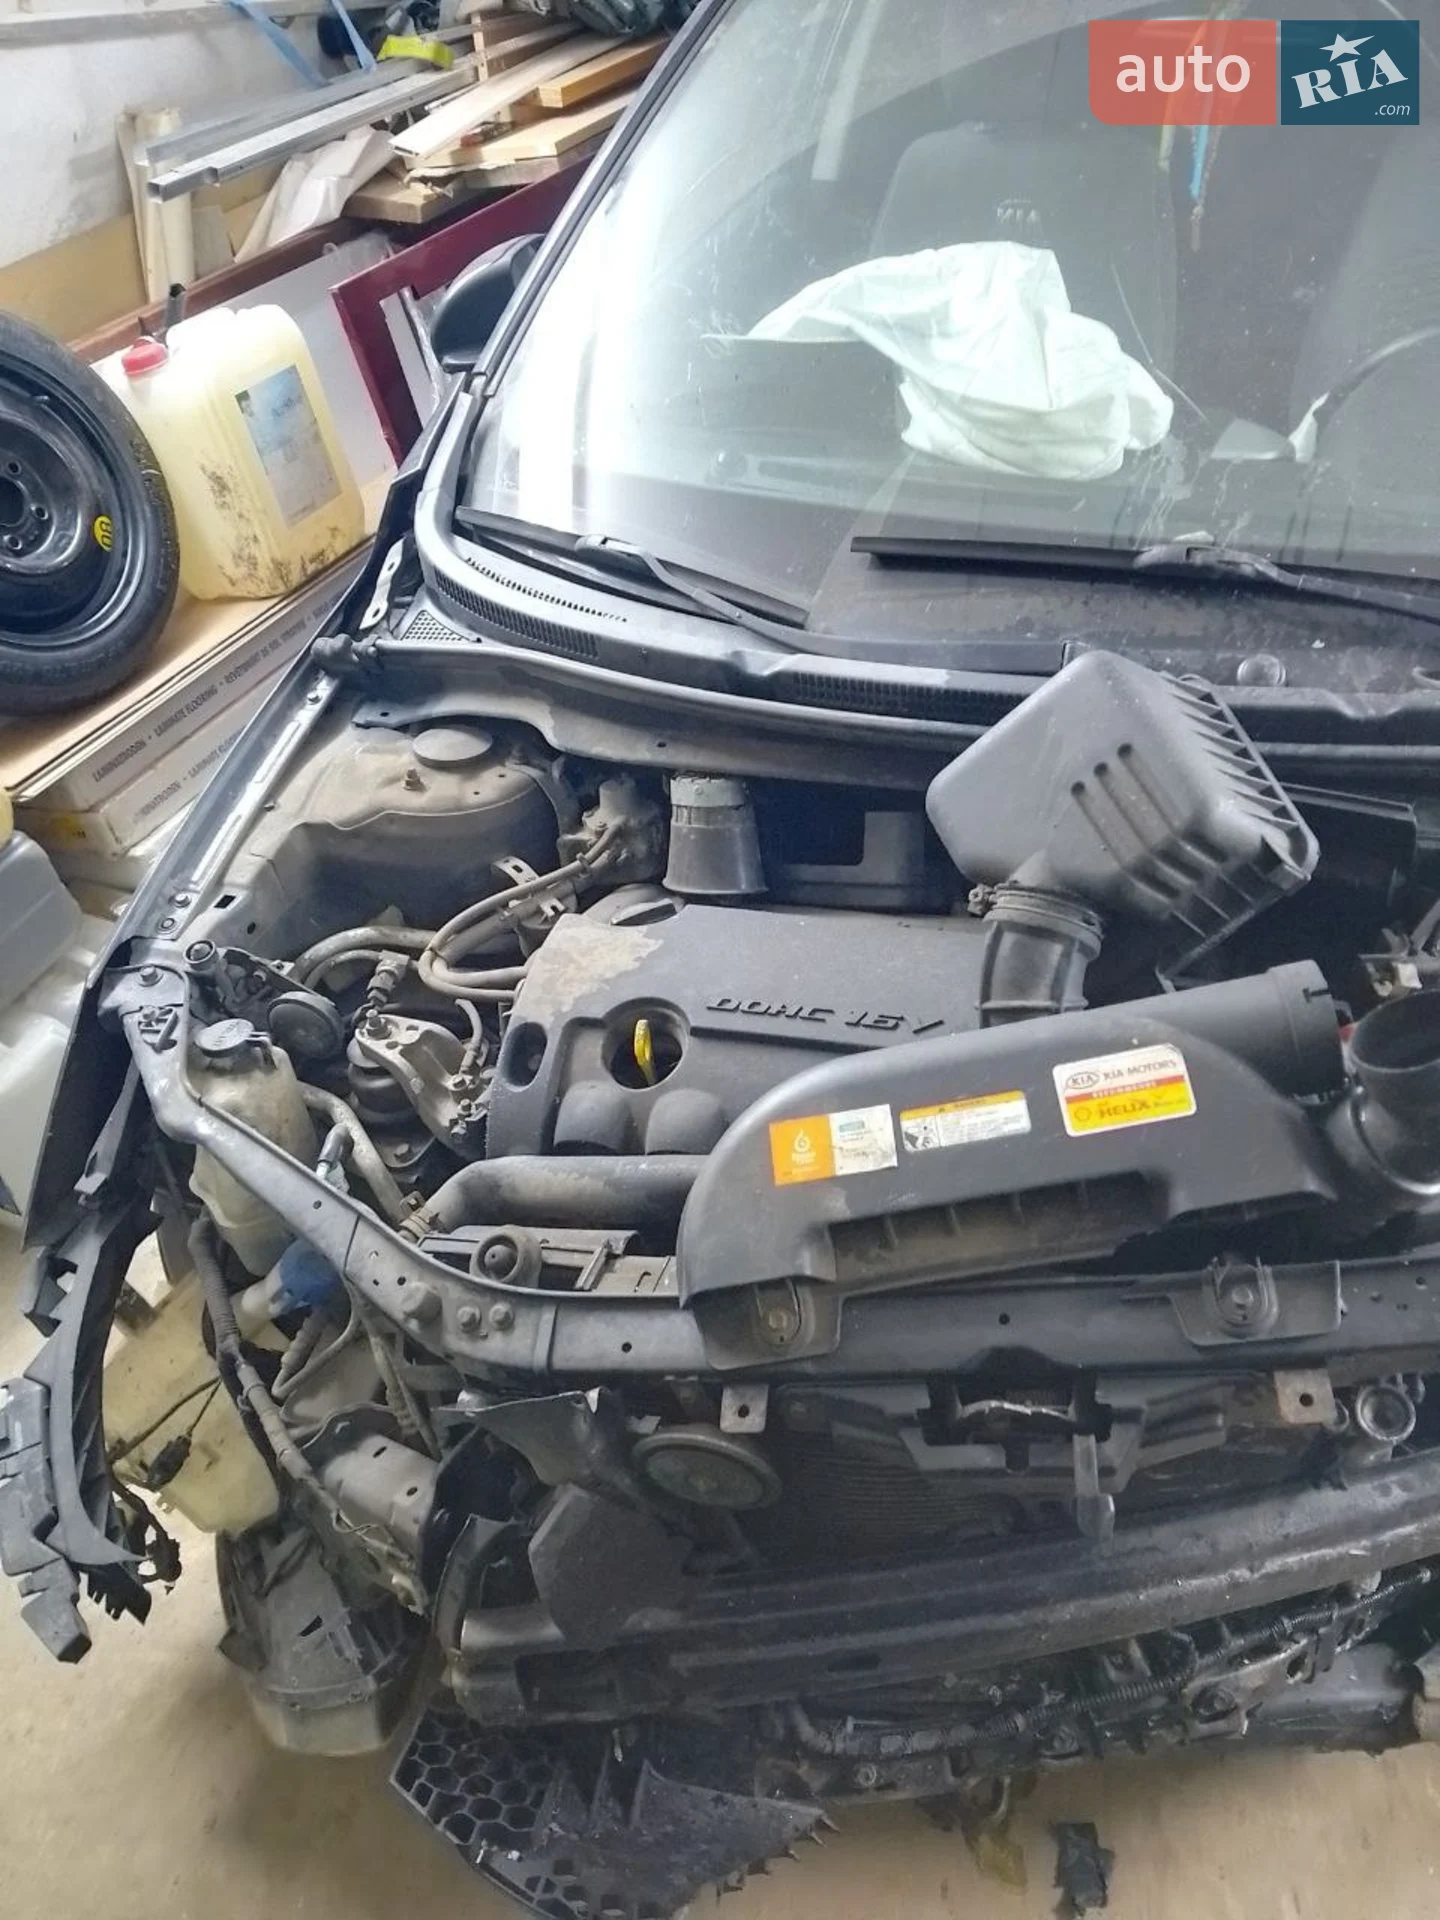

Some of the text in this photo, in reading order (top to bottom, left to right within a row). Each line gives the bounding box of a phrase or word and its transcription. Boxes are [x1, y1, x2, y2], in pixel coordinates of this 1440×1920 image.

[706, 998, 835, 1023] DOHC
[1071, 1059, 1177, 1087] KIA KIA MOTORS
[1099, 1100, 1151, 1119] HELIX
